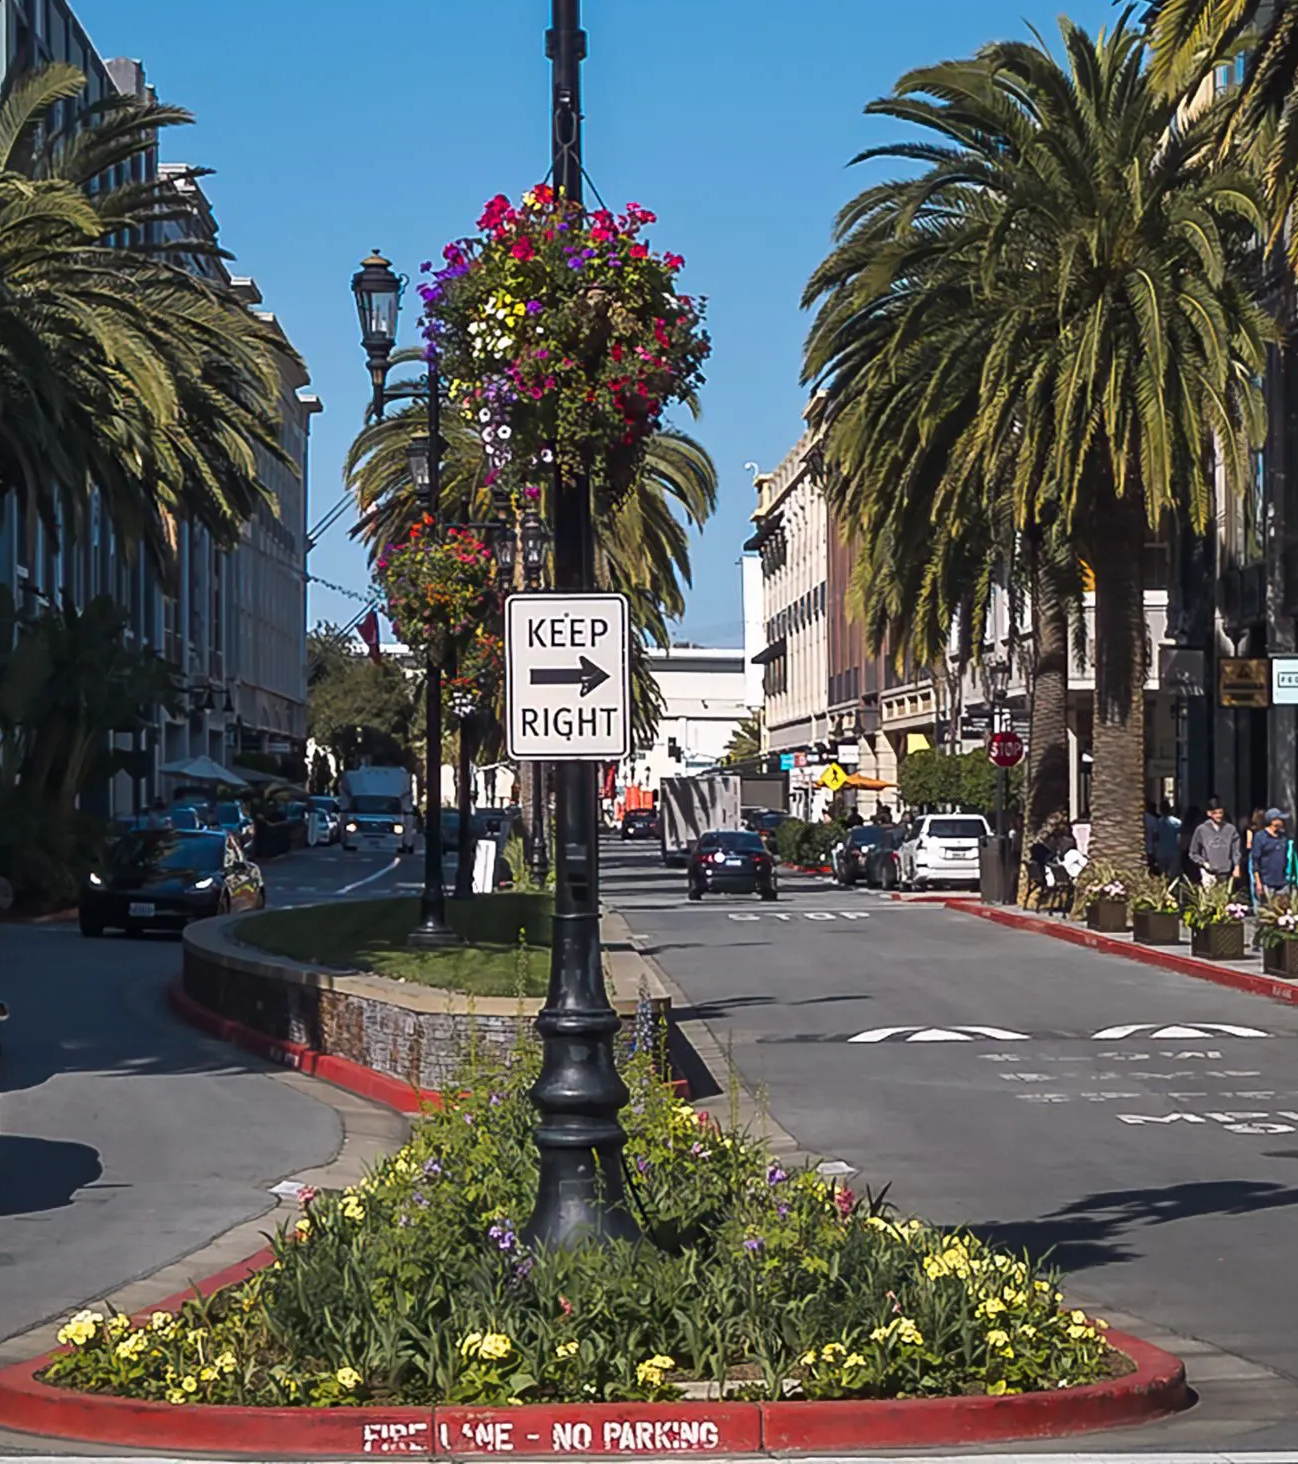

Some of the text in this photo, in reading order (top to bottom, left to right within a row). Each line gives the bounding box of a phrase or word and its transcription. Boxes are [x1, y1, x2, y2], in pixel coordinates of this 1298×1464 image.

[527, 618, 609, 648] KEEP
[521, 707, 618, 737] RIGHT
[990, 741, 1022, 757] STOP
[552, 1422, 592, 1451] NO
[603, 1420, 719, 1450] PARKING
